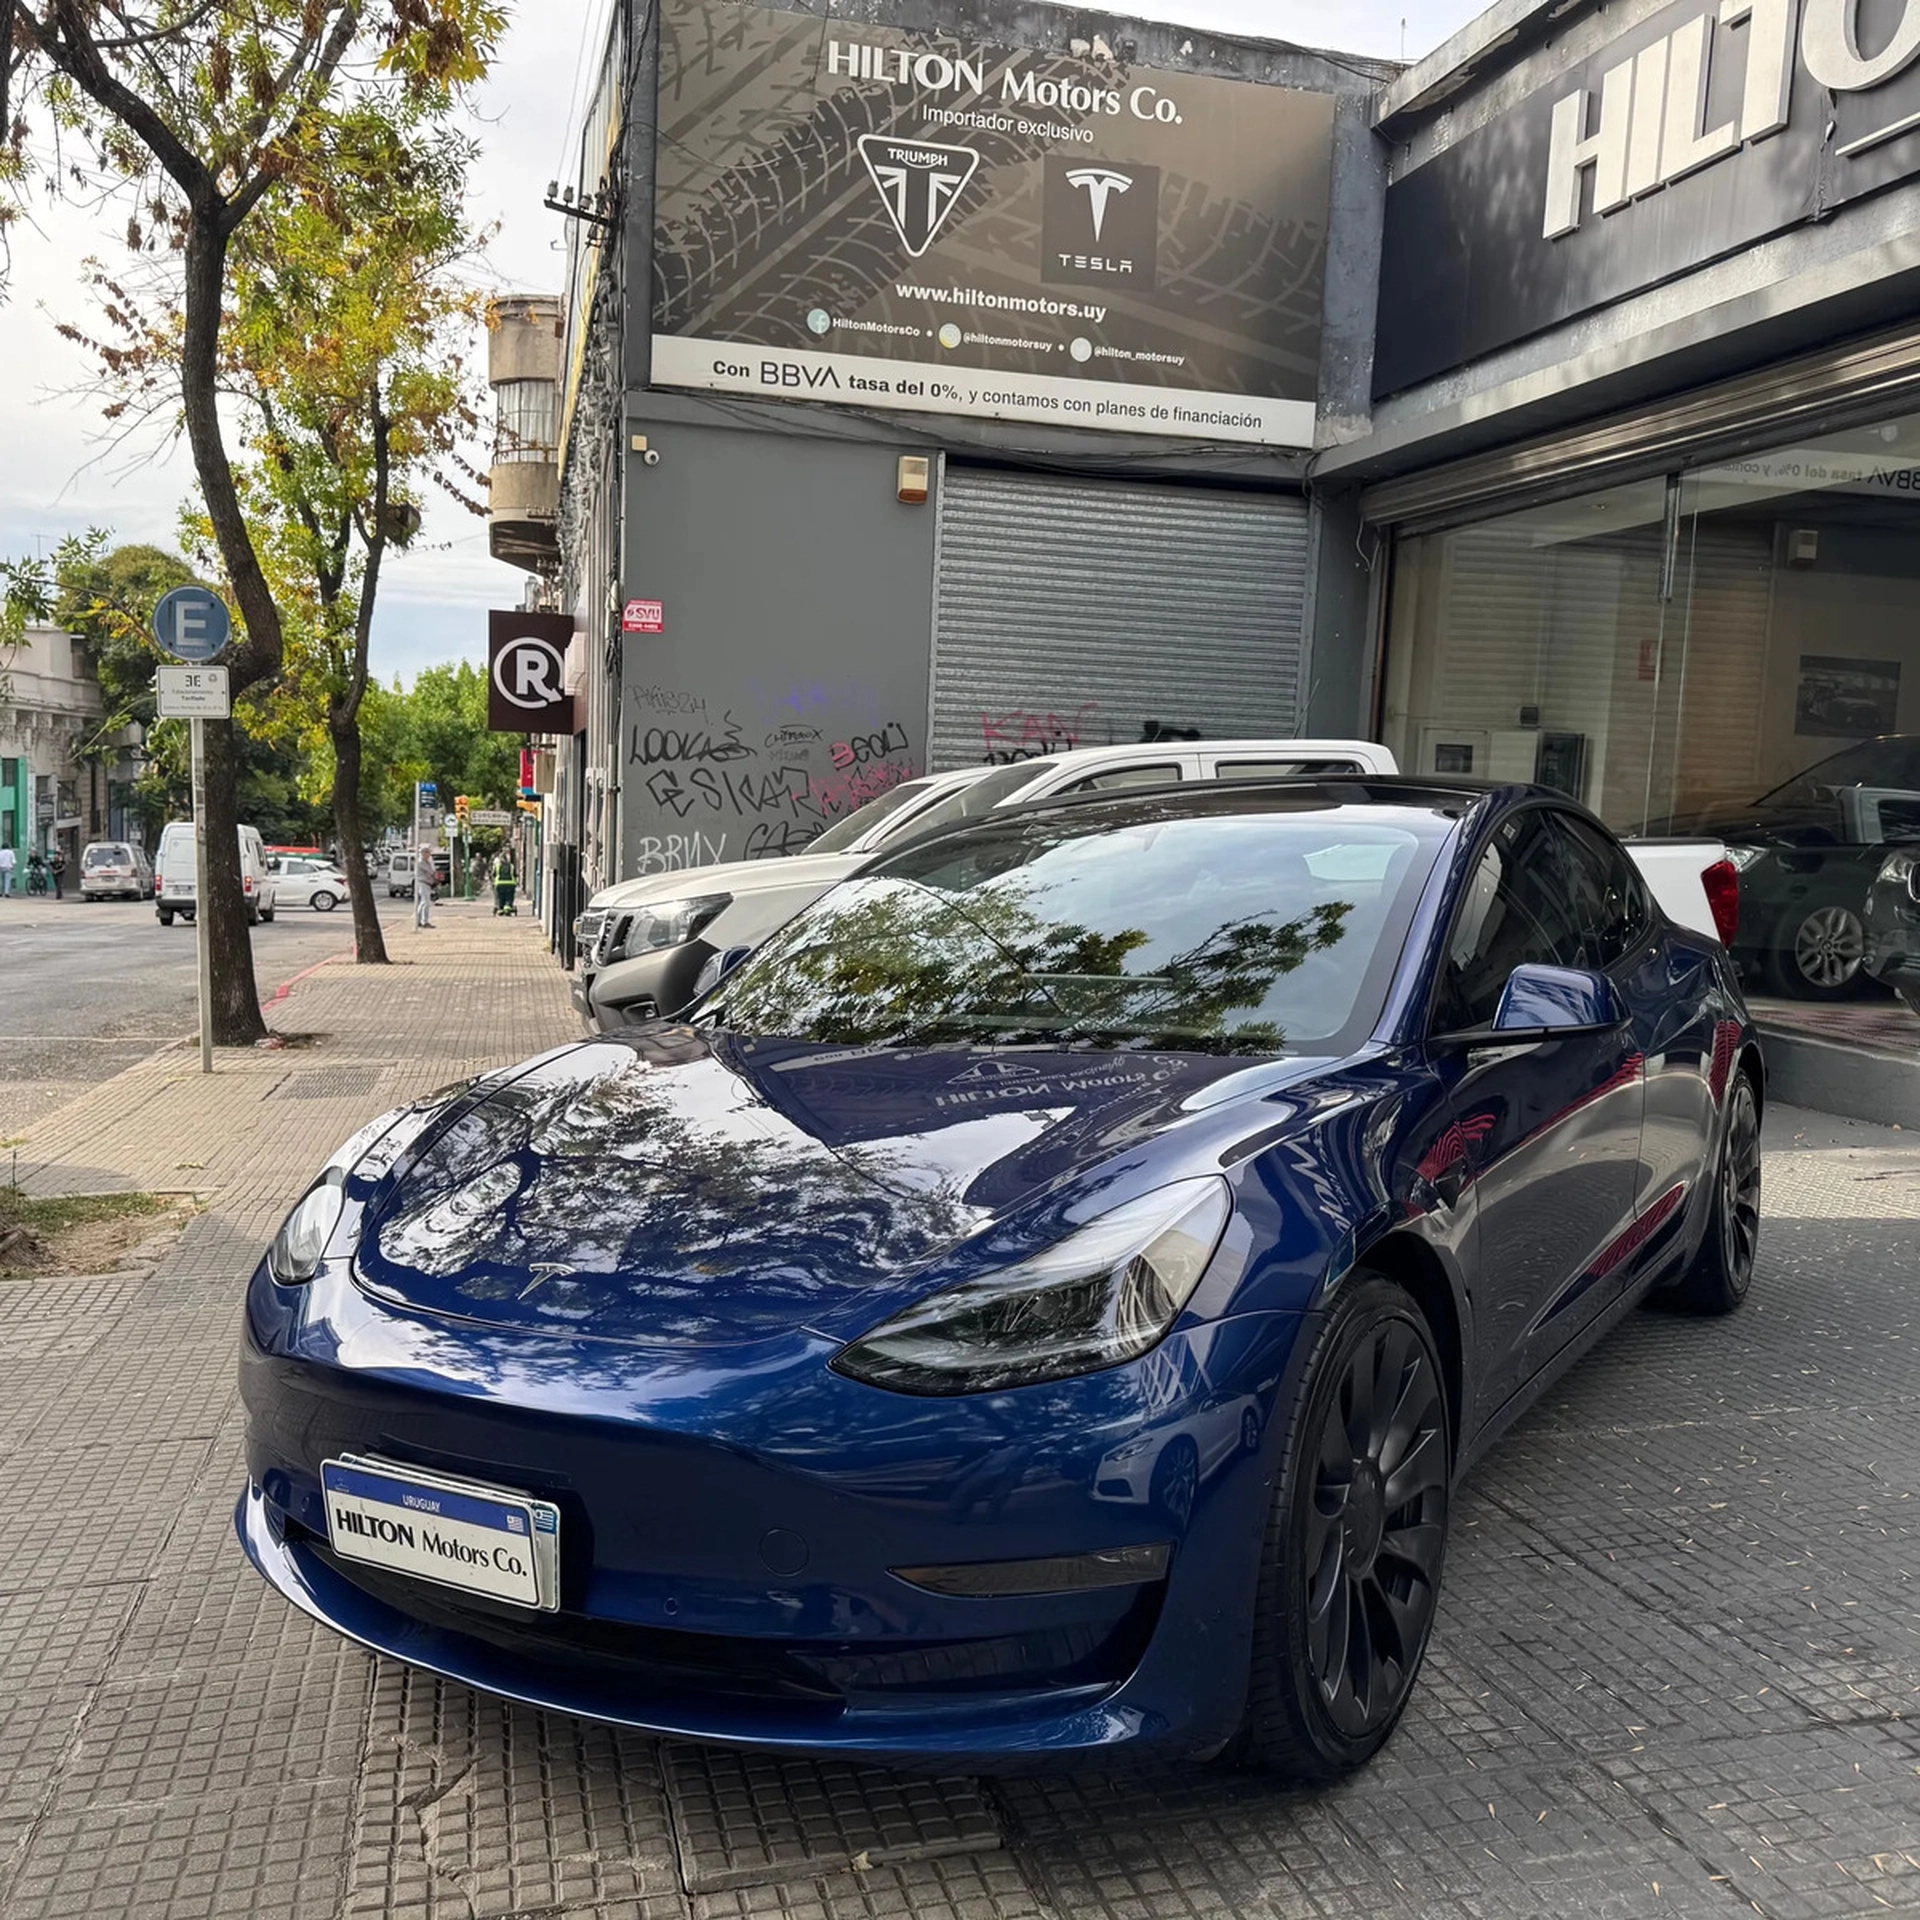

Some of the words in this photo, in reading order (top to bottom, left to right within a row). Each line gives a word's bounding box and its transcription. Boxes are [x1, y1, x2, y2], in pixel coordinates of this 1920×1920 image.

[828, 40, 983, 94] HILTON
[1001, 67, 1121, 115] Motors
[1130, 86, 1183, 124] Co.
[923, 104, 1013, 132] Importador
[1017, 115, 1094, 143] exclusivo
[887, 148, 948, 167] TRIUMPH
[1058, 253, 1133, 273] TESLA
[896, 284, 1107, 323] www.hiltonmotors.uy
[833, 318, 921, 337] HiltonMotorsCo
[963, 332, 1053, 352] @hiltonmotorsuy
[1094, 346, 1185, 366] @hilton_motorsuy
[713, 360, 750, 377] Con
[760, 361, 840, 389] BBVA
[848, 375, 890, 393] tasa
[896, 379, 924, 396] del
[930, 383, 963, 401] 0%,
[968, 388, 978, 404] y
[982, 391, 1059, 409] contamos
[1063, 397, 1091, 412] con
[1096, 400, 1146, 418] planes
[1150, 404, 1169, 420] de
[1173, 406, 1262, 428] financiación
[176, 601, 208, 646] E
[402, 1494, 441, 1513] URUGUAY
[336, 1508, 415, 1548] HILTON
[423, 1530, 489, 1567] Motors
[493, 1546, 527, 1577] Co.
